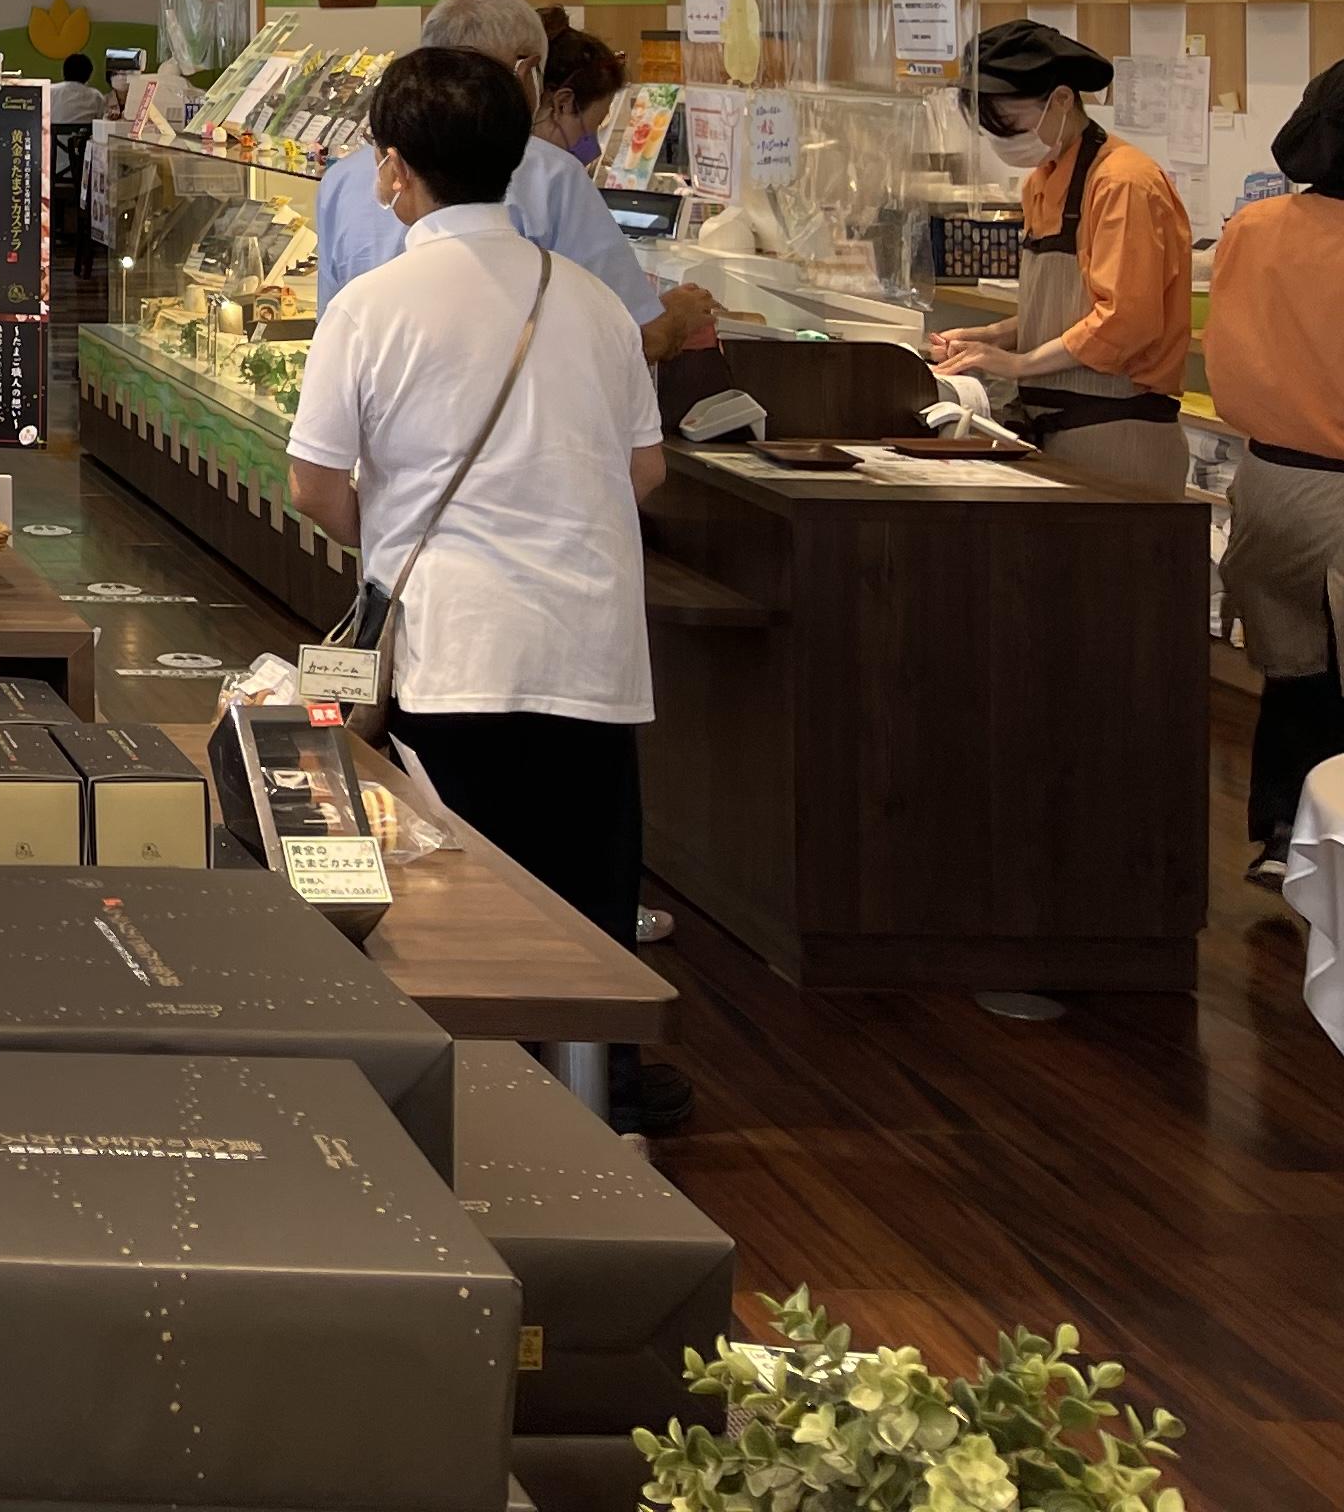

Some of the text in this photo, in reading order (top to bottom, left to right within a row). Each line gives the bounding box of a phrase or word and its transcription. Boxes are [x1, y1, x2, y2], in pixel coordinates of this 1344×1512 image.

[11, 130, 23, 251] 黄金のたまごカステラ
[311, 708, 339, 721] 見本
[295, 858, 375, 868] たまごカステラ
